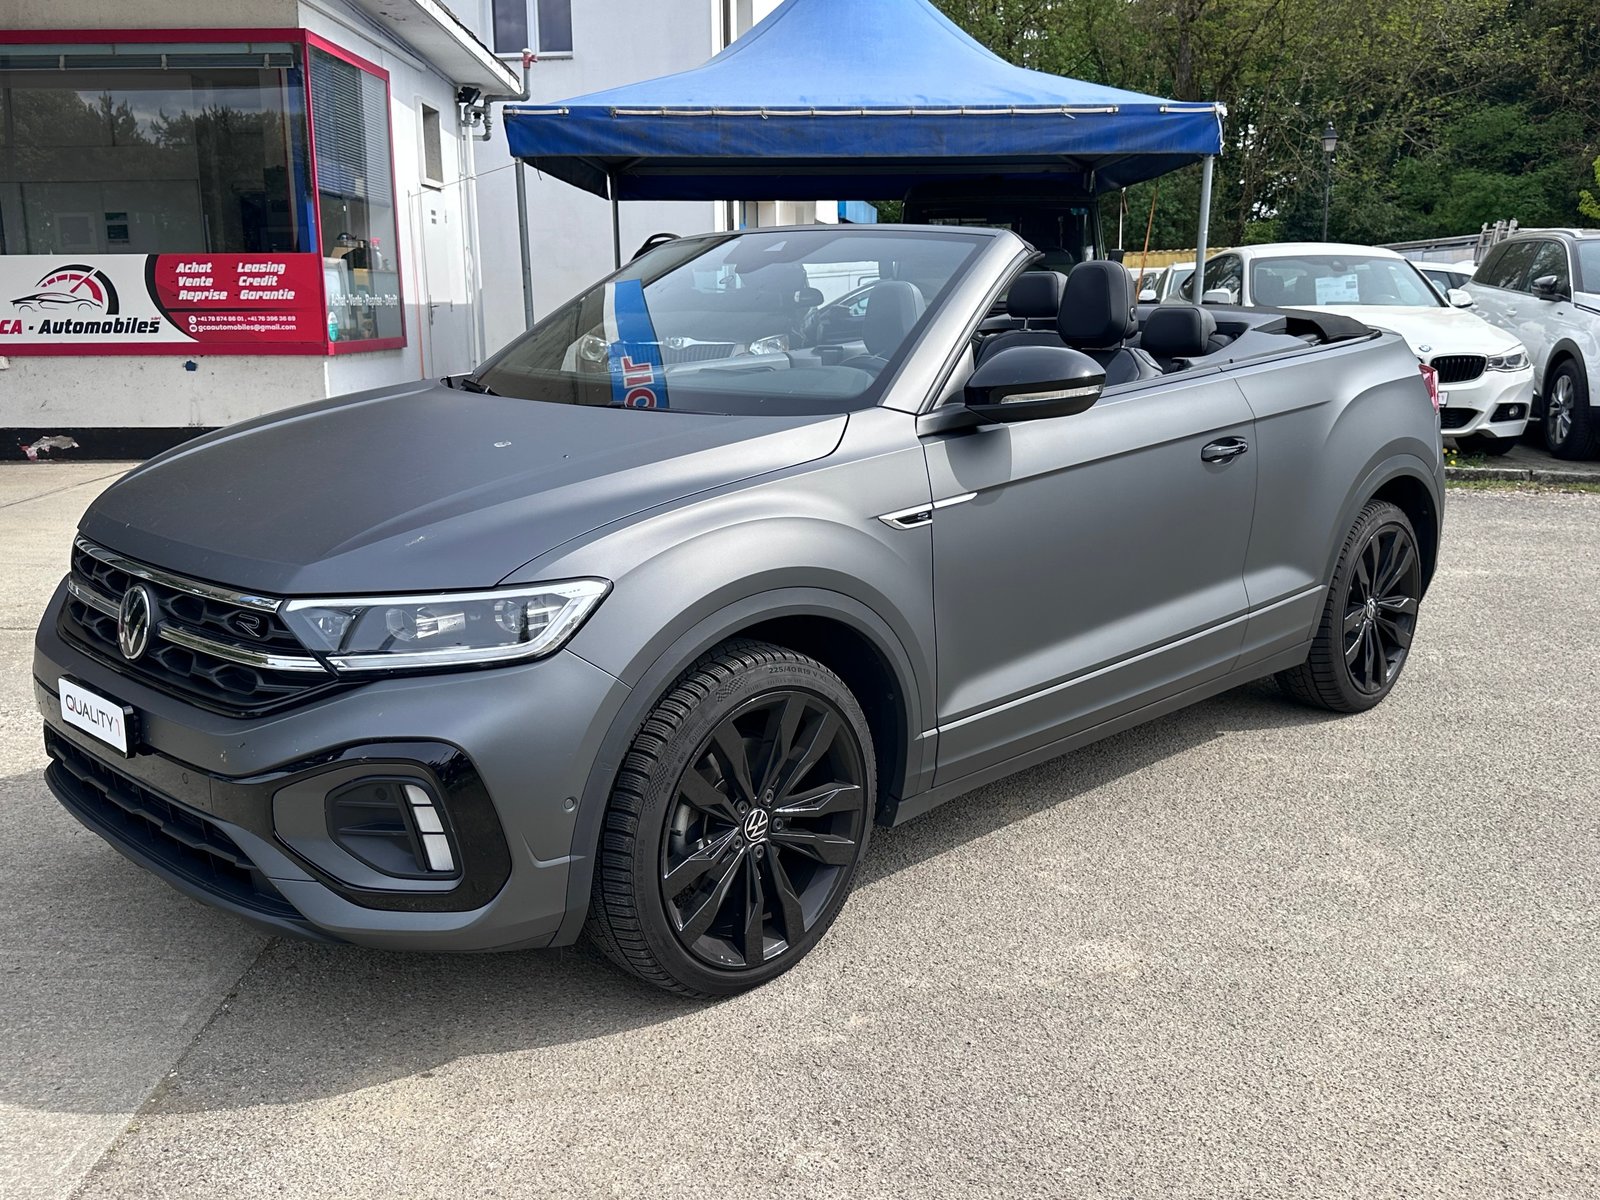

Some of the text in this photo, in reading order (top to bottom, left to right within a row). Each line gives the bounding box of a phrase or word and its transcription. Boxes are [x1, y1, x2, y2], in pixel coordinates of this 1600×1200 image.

[176, 262, 212, 273] Achat
[237, 261, 286, 274] Leasing
[178, 276, 213, 287] Vente
[238, 275, 278, 286] Credit
[179, 289, 228, 302] Reprise
[239, 288, 295, 300] Garantie
[38, 318, 160, 335] Automobiles
[65, 694, 121, 737] QUALITY 1
